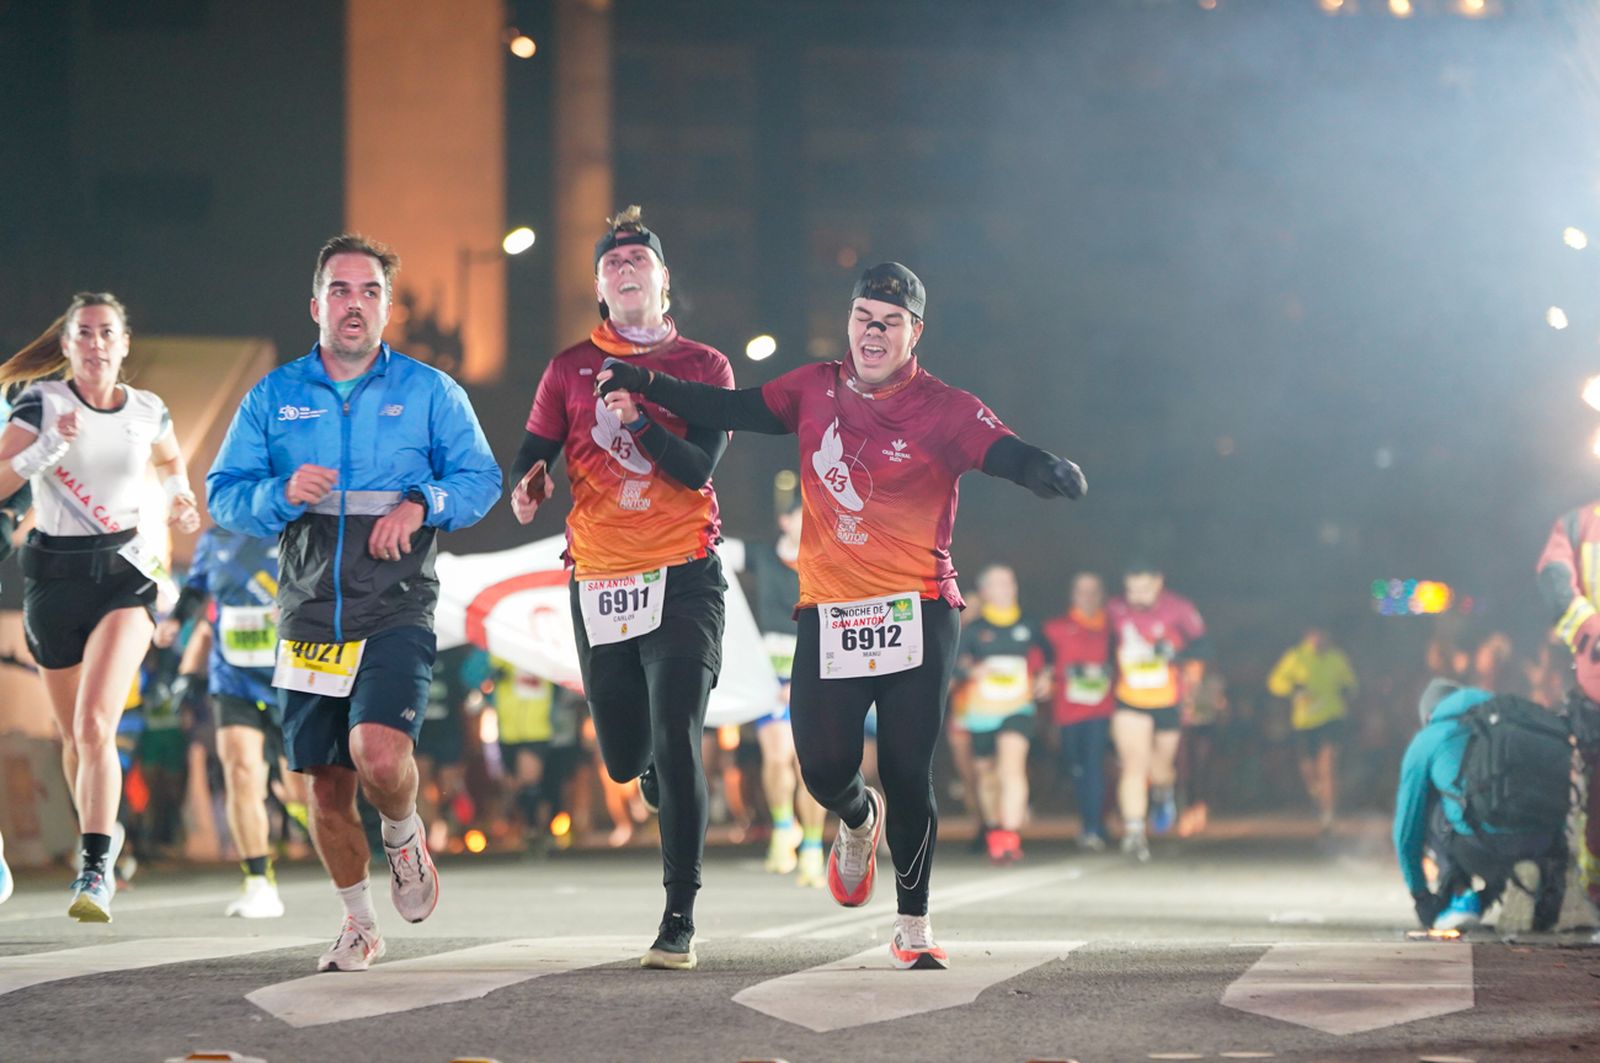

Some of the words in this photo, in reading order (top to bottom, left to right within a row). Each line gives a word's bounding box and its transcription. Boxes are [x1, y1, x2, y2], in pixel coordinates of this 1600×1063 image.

[611, 436, 633, 460] 43
[53, 465, 92, 507] MALA
[824, 466, 848, 493] 43
[587, 582, 606, 592] SAN
[598, 586, 650, 616] 6911
[843, 606, 871, 618] NOCHE
[873, 605, 884, 613] DE
[832, 619, 852, 629] SAN
[841, 624, 902, 652] 6912
